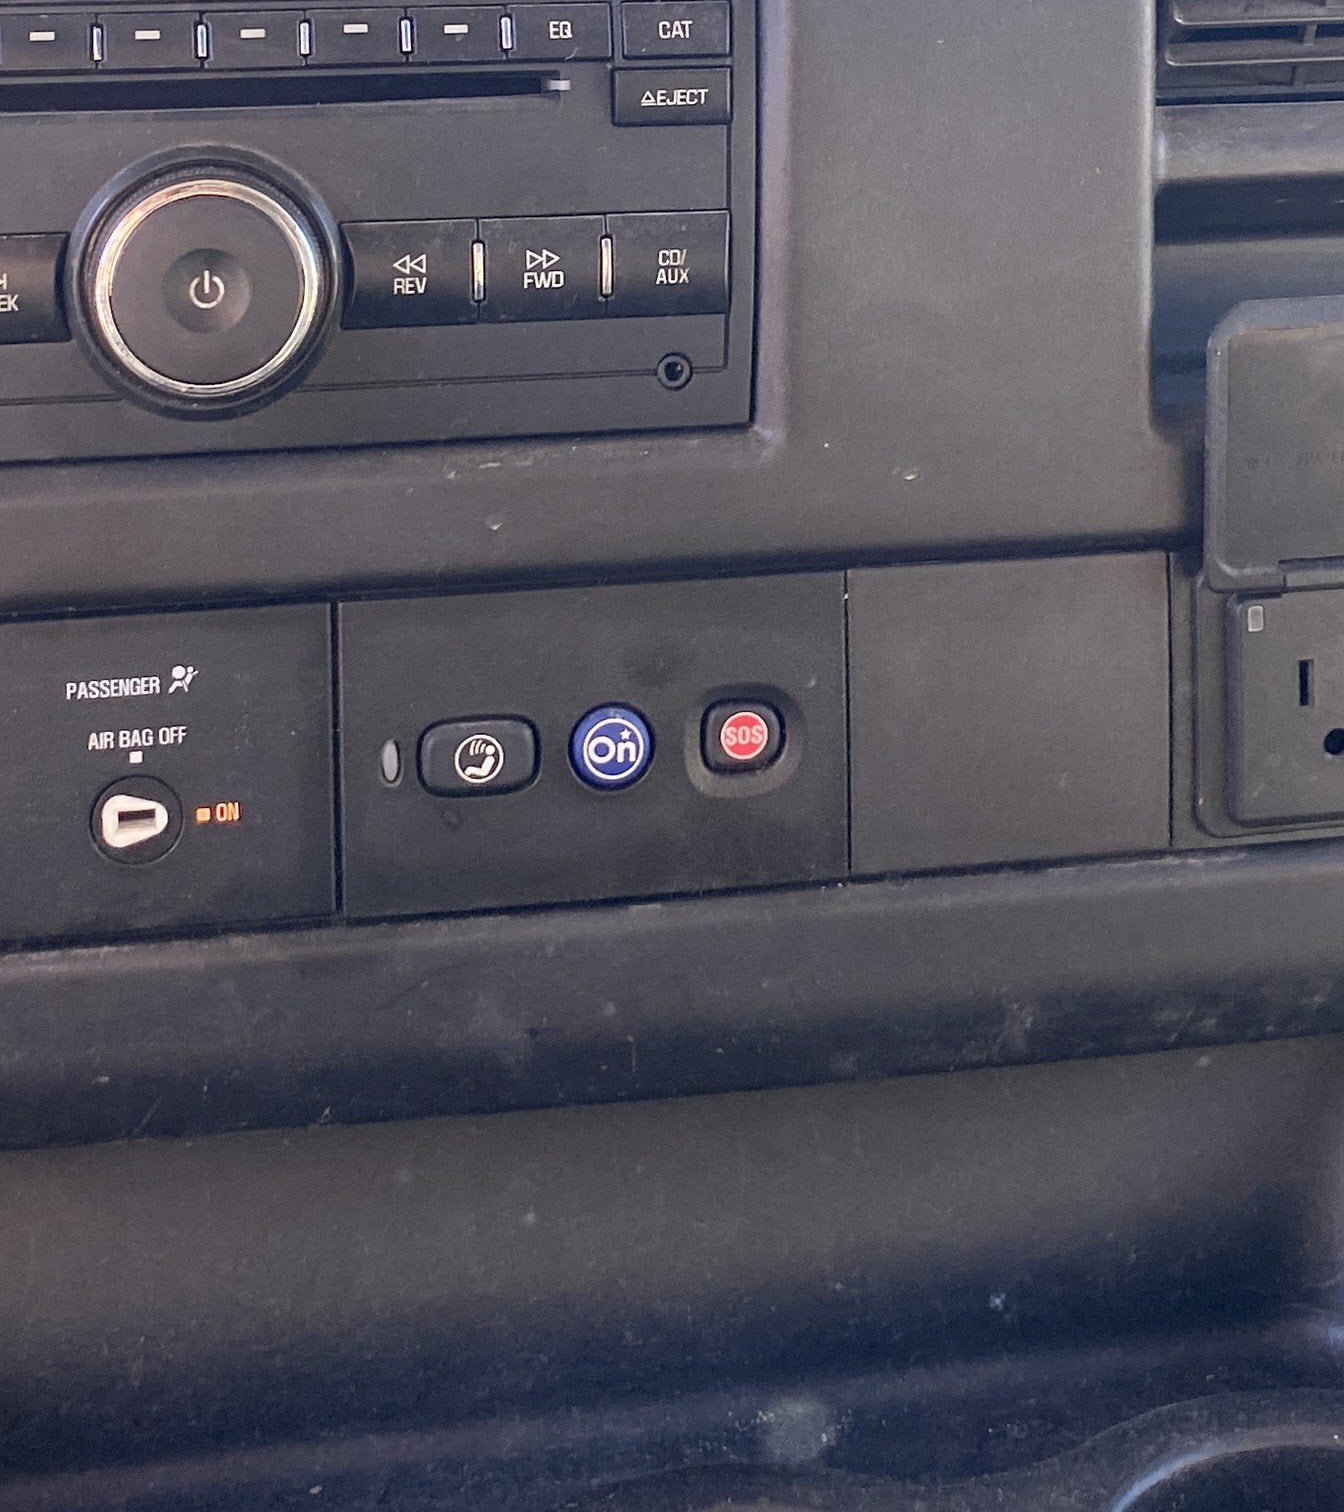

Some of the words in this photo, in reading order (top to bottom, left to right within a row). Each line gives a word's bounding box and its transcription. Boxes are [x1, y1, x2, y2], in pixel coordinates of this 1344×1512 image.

[548, 20, 573, 40] EQ
[658, 20, 693, 40] CAT
[657, 88, 709, 106] EJECT
[657, 248, 687, 267] CD/
[393, 277, 427, 295] REV
[523, 270, 565, 289] FWD
[655, 267, 690, 285] AUX
[65, 676, 161, 700] PASSENGER
[87, 731, 115, 751] AIR
[118, 728, 154, 748] BAG
[158, 725, 188, 745] OFF
[724, 724, 764, 746] SOS
[588, 735, 638, 764] On
[215, 801, 241, 823] ON
